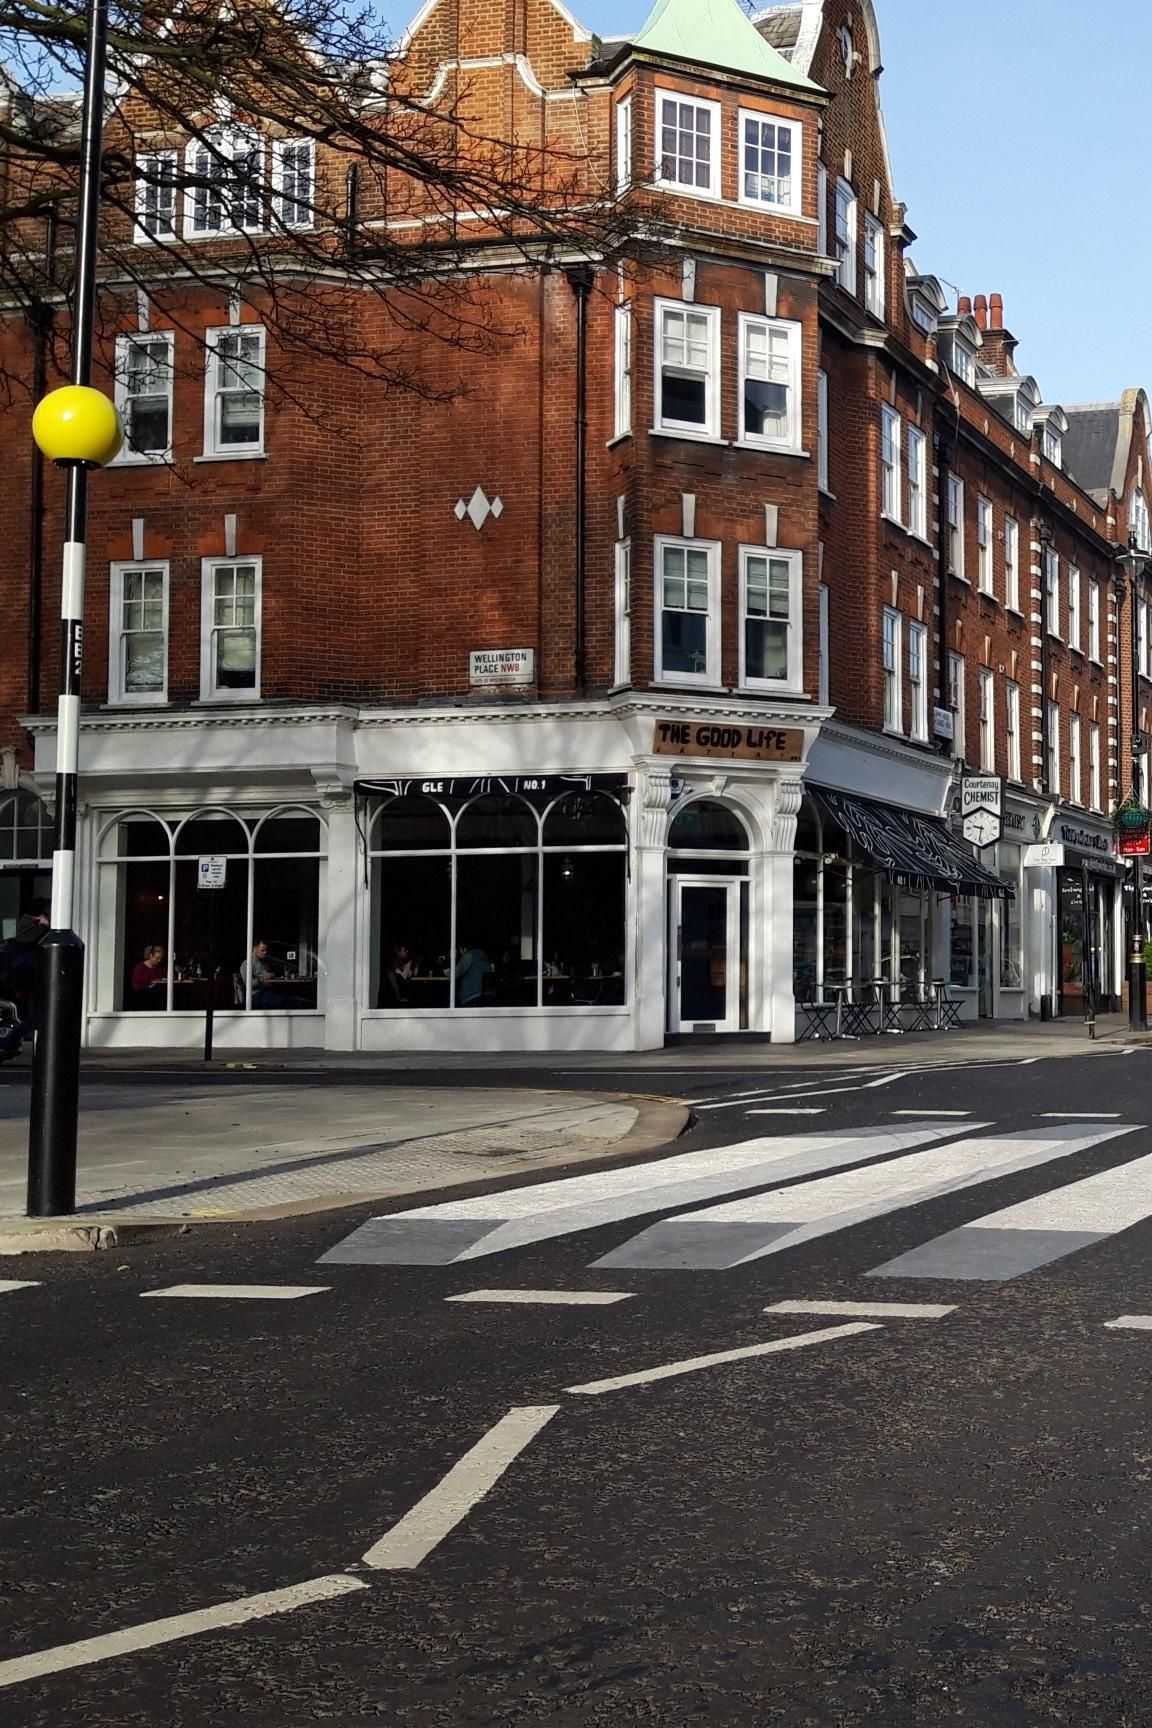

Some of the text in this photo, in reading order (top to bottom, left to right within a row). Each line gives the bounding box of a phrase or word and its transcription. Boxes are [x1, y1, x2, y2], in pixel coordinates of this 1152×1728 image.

[474, 653, 527, 663] WELLINGTON
[474, 663, 520, 674] PLACE NW8
[658, 723, 787, 751] THE GOOD LIFE
[422, 779, 546, 793] GLE NO.1
[964, 779, 999, 790] Courtenay
[964, 791, 1000, 805] CHEMIST
